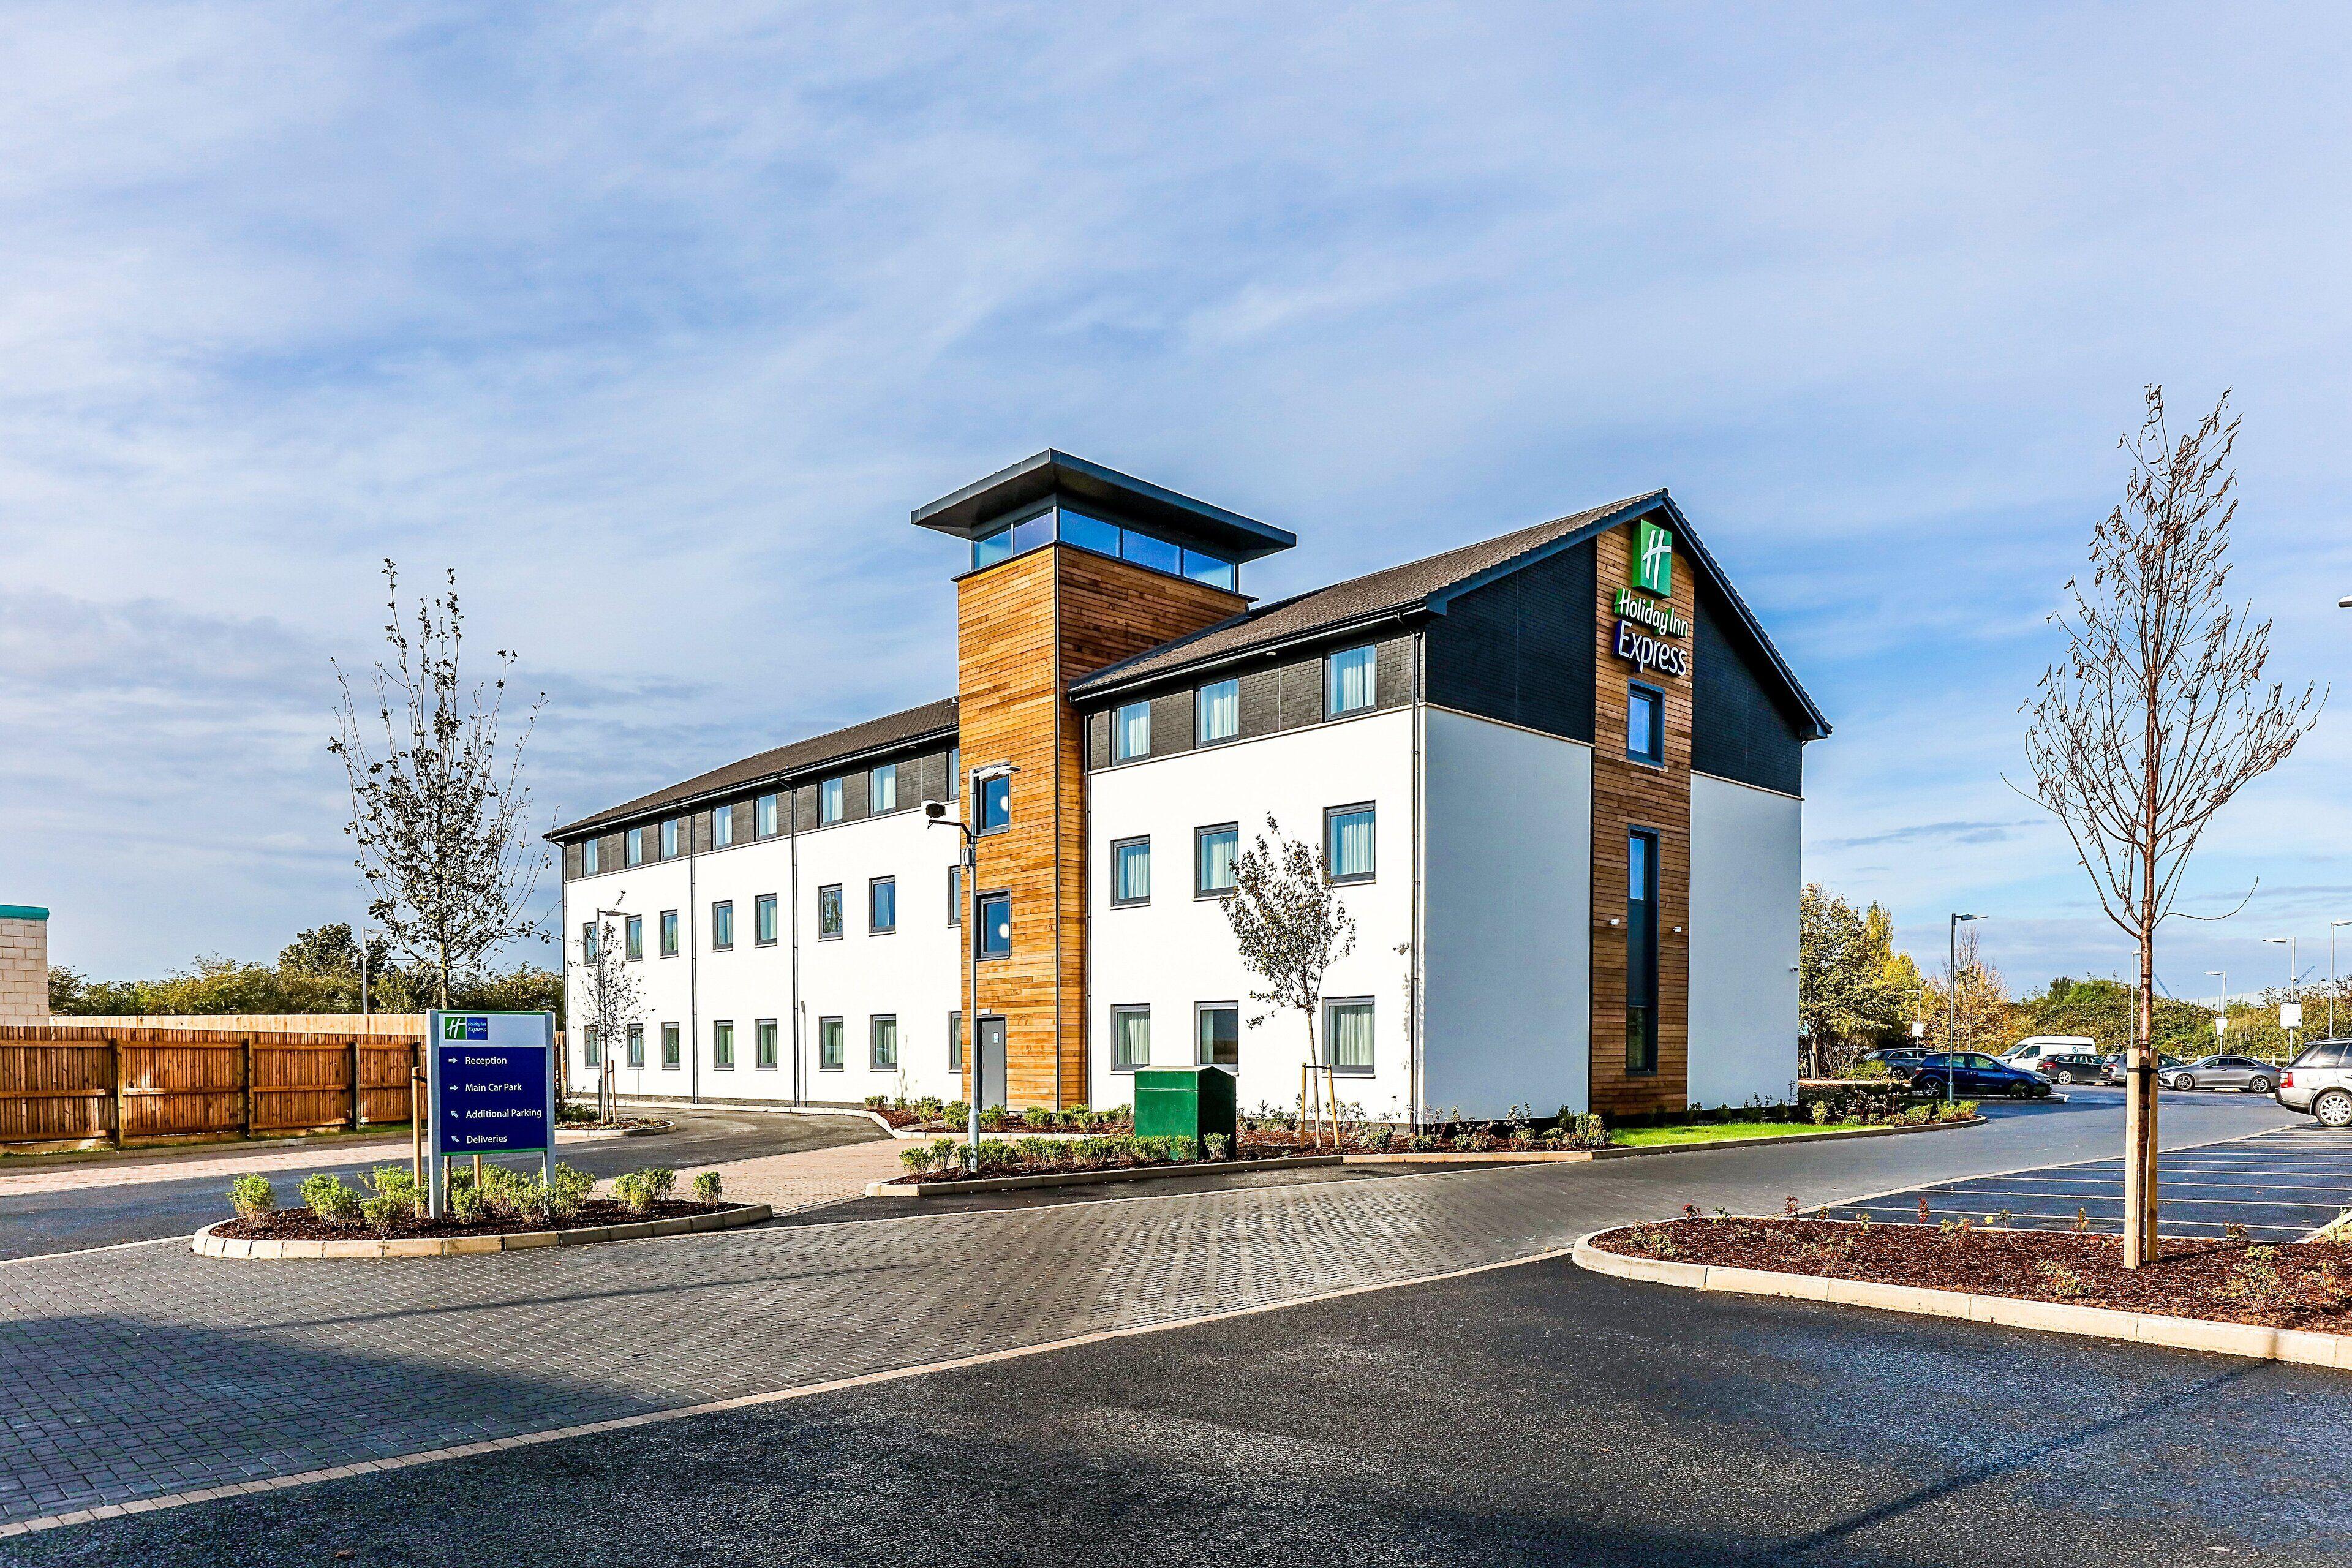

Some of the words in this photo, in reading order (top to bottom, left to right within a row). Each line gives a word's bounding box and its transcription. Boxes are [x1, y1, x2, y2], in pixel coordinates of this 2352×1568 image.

[1619, 587, 1668, 636] Holiday
[1669, 607, 1689, 638] Inn
[1618, 619, 1688, 676] Express
[466, 1057, 507, 1066] Reception
[504, 1082, 522, 1091] Park
[466, 1109, 510, 1118] Additional
[511, 1108, 542, 1118] Parking
[467, 1134, 508, 1144] Deliveries
